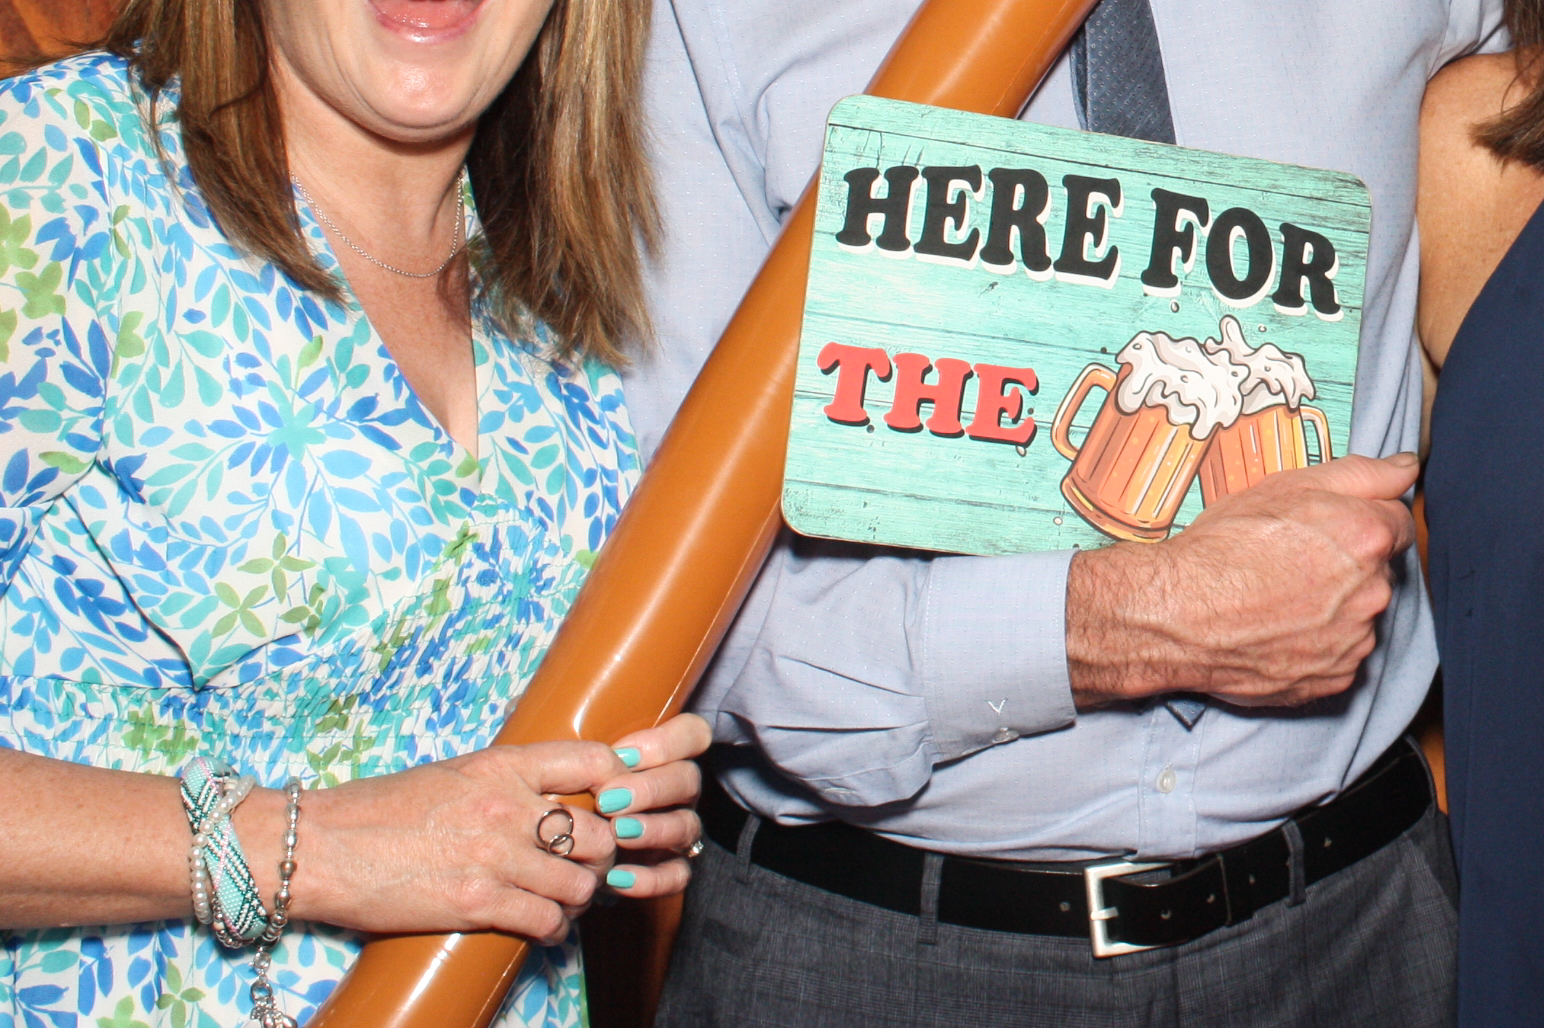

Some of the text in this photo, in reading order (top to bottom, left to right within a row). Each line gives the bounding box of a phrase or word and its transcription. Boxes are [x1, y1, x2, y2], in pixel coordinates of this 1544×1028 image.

[835, 165, 1344, 322] HERE FOR
[816, 341, 1040, 447] THE
